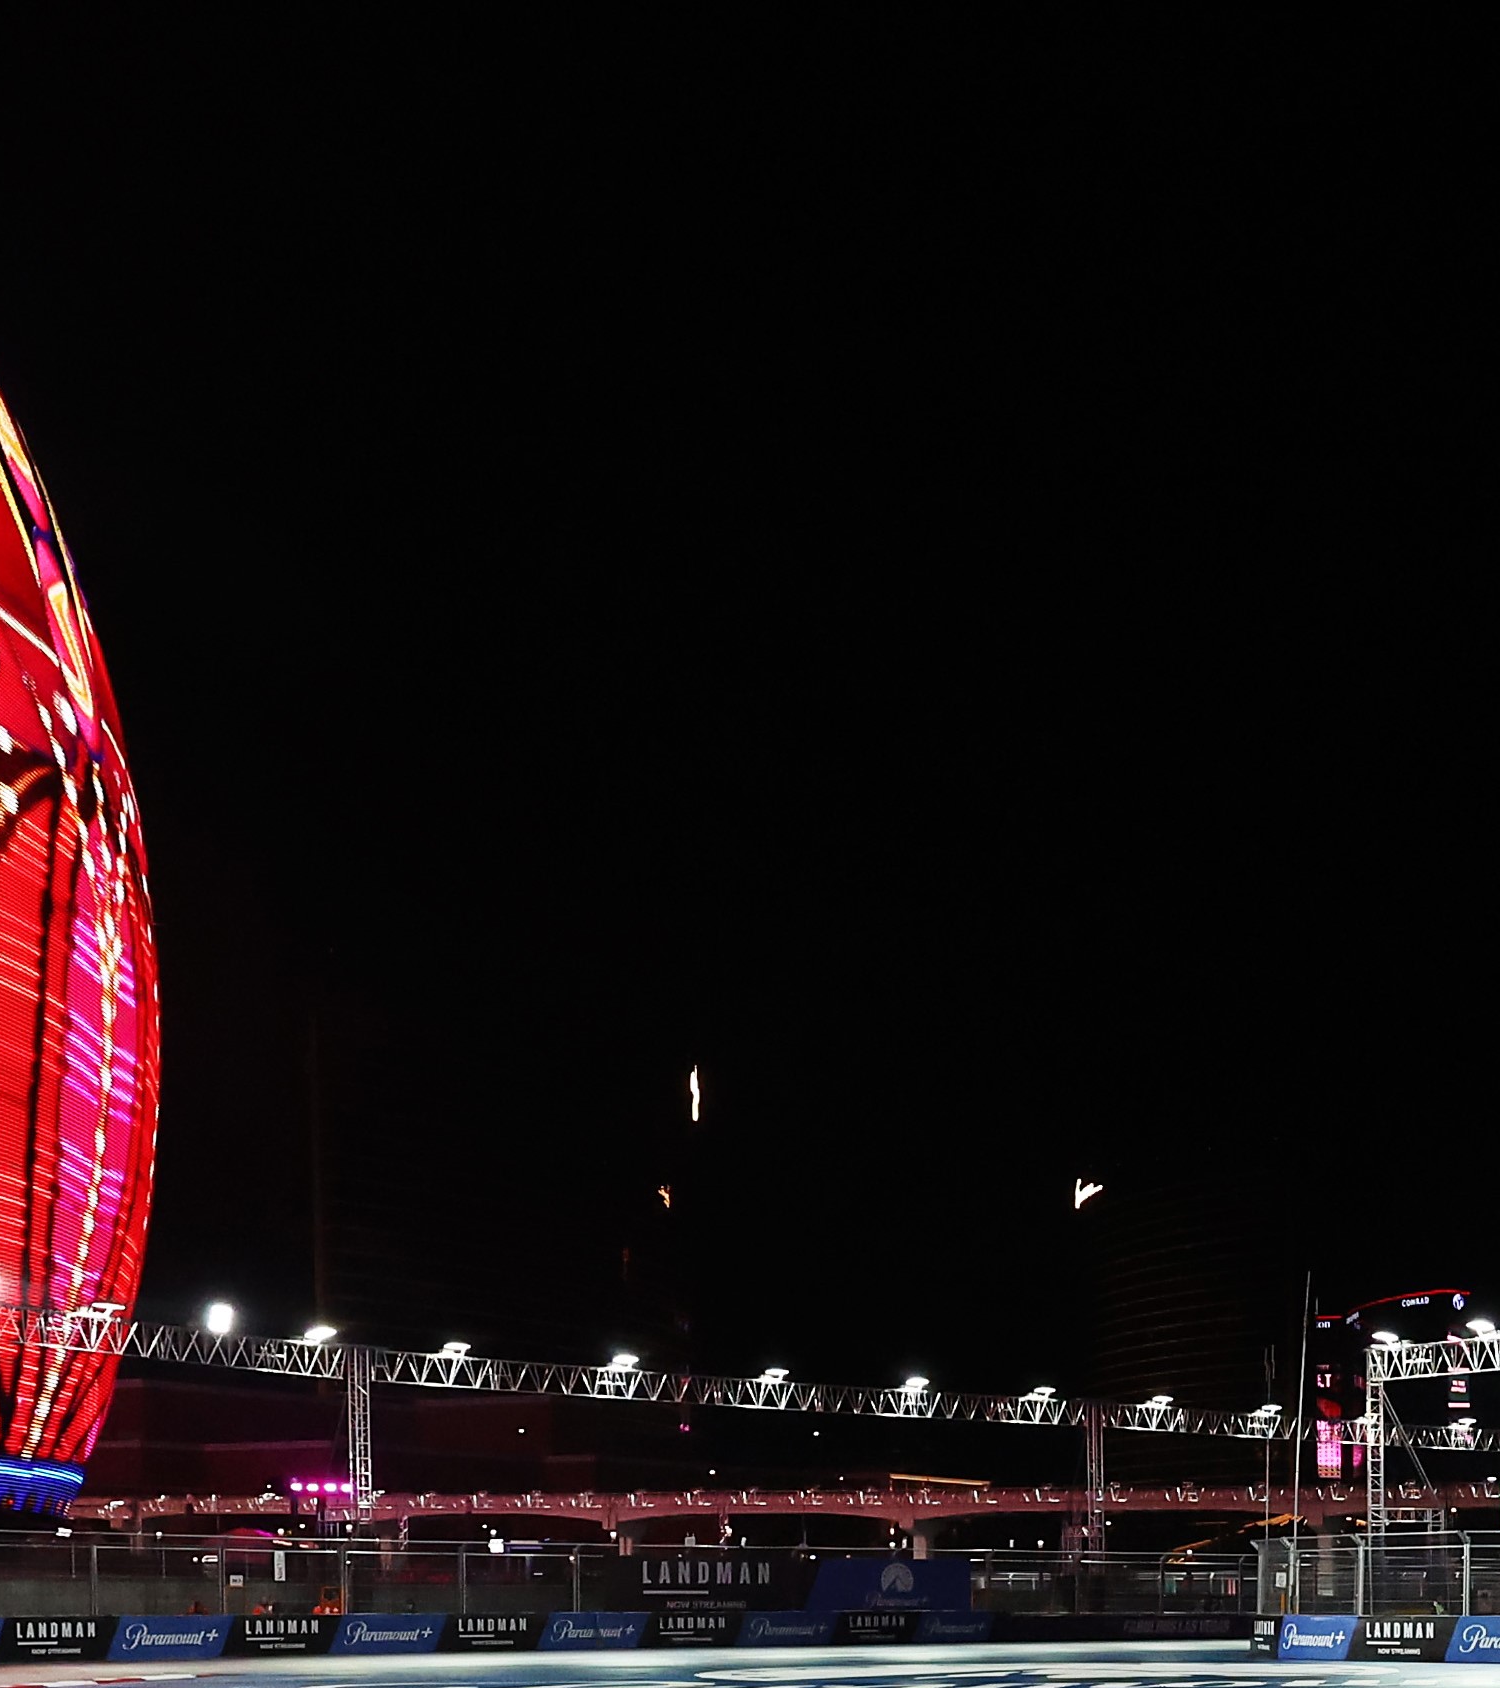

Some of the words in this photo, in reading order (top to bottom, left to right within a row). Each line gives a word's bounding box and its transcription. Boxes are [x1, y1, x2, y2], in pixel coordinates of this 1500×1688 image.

[1401, 1296, 1430, 1308] CONRAD
[642, 1559, 770, 1585] LANDMAN
[16, 1621, 96, 1639] LANDMAN
[245, 1619, 319, 1635] LANDMAN
[343, 1621, 433, 1645] Paramount+
[458, 1617, 527, 1632] LANDMAN
[1365, 1621, 1434, 1639] LANDMAN
[121, 1623, 219, 1650] Paramount+
